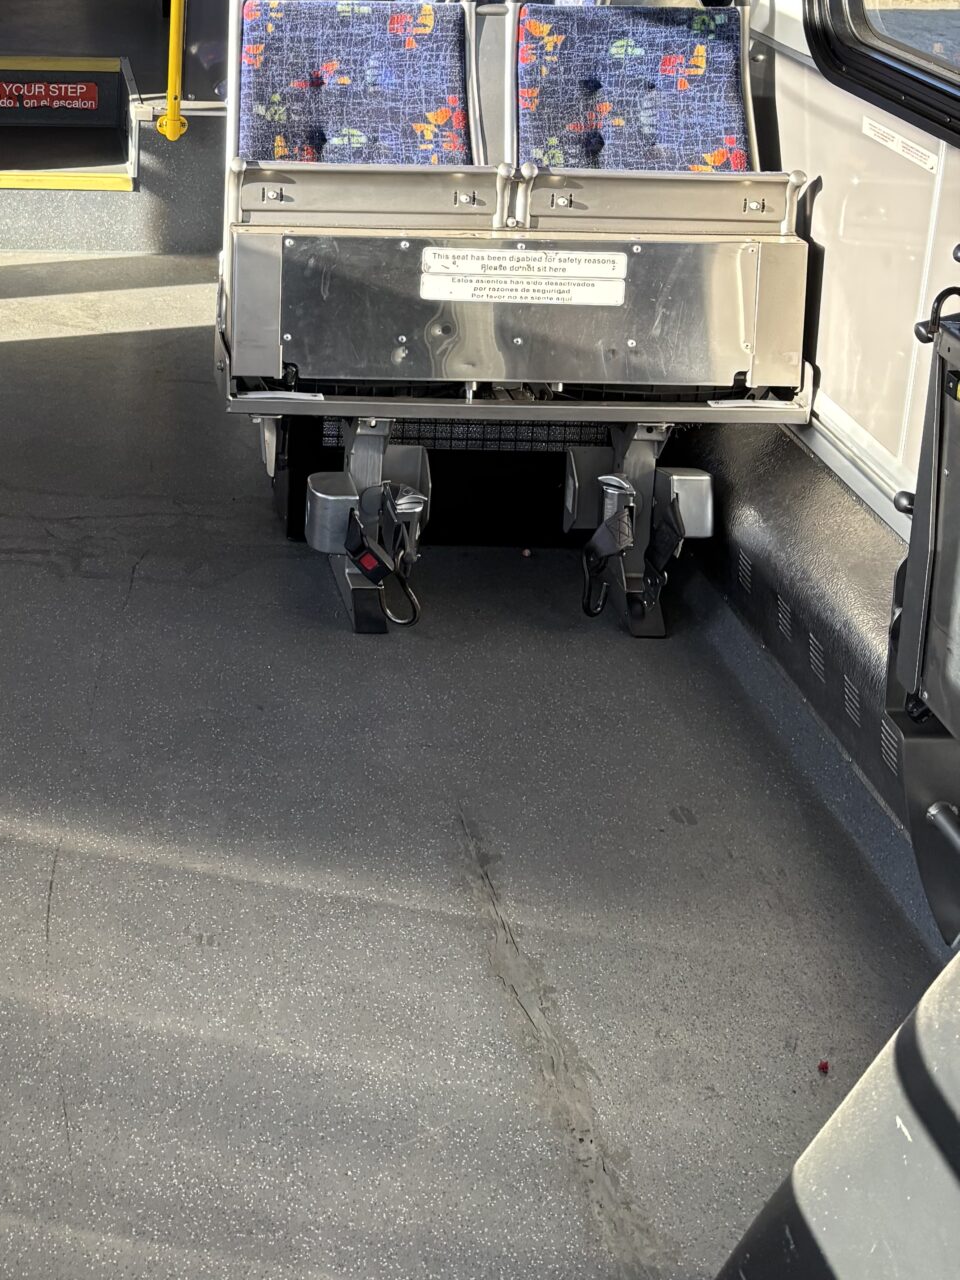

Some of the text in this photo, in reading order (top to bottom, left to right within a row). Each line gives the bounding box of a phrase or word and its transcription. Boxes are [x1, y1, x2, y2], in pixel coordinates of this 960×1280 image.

[3, 84, 45, 96] YOUR
[49, 84, 87, 97] STEP
[487, 254, 507, 262] been
[508, 255, 543, 263] disabled
[558, 257, 582, 265] safety
